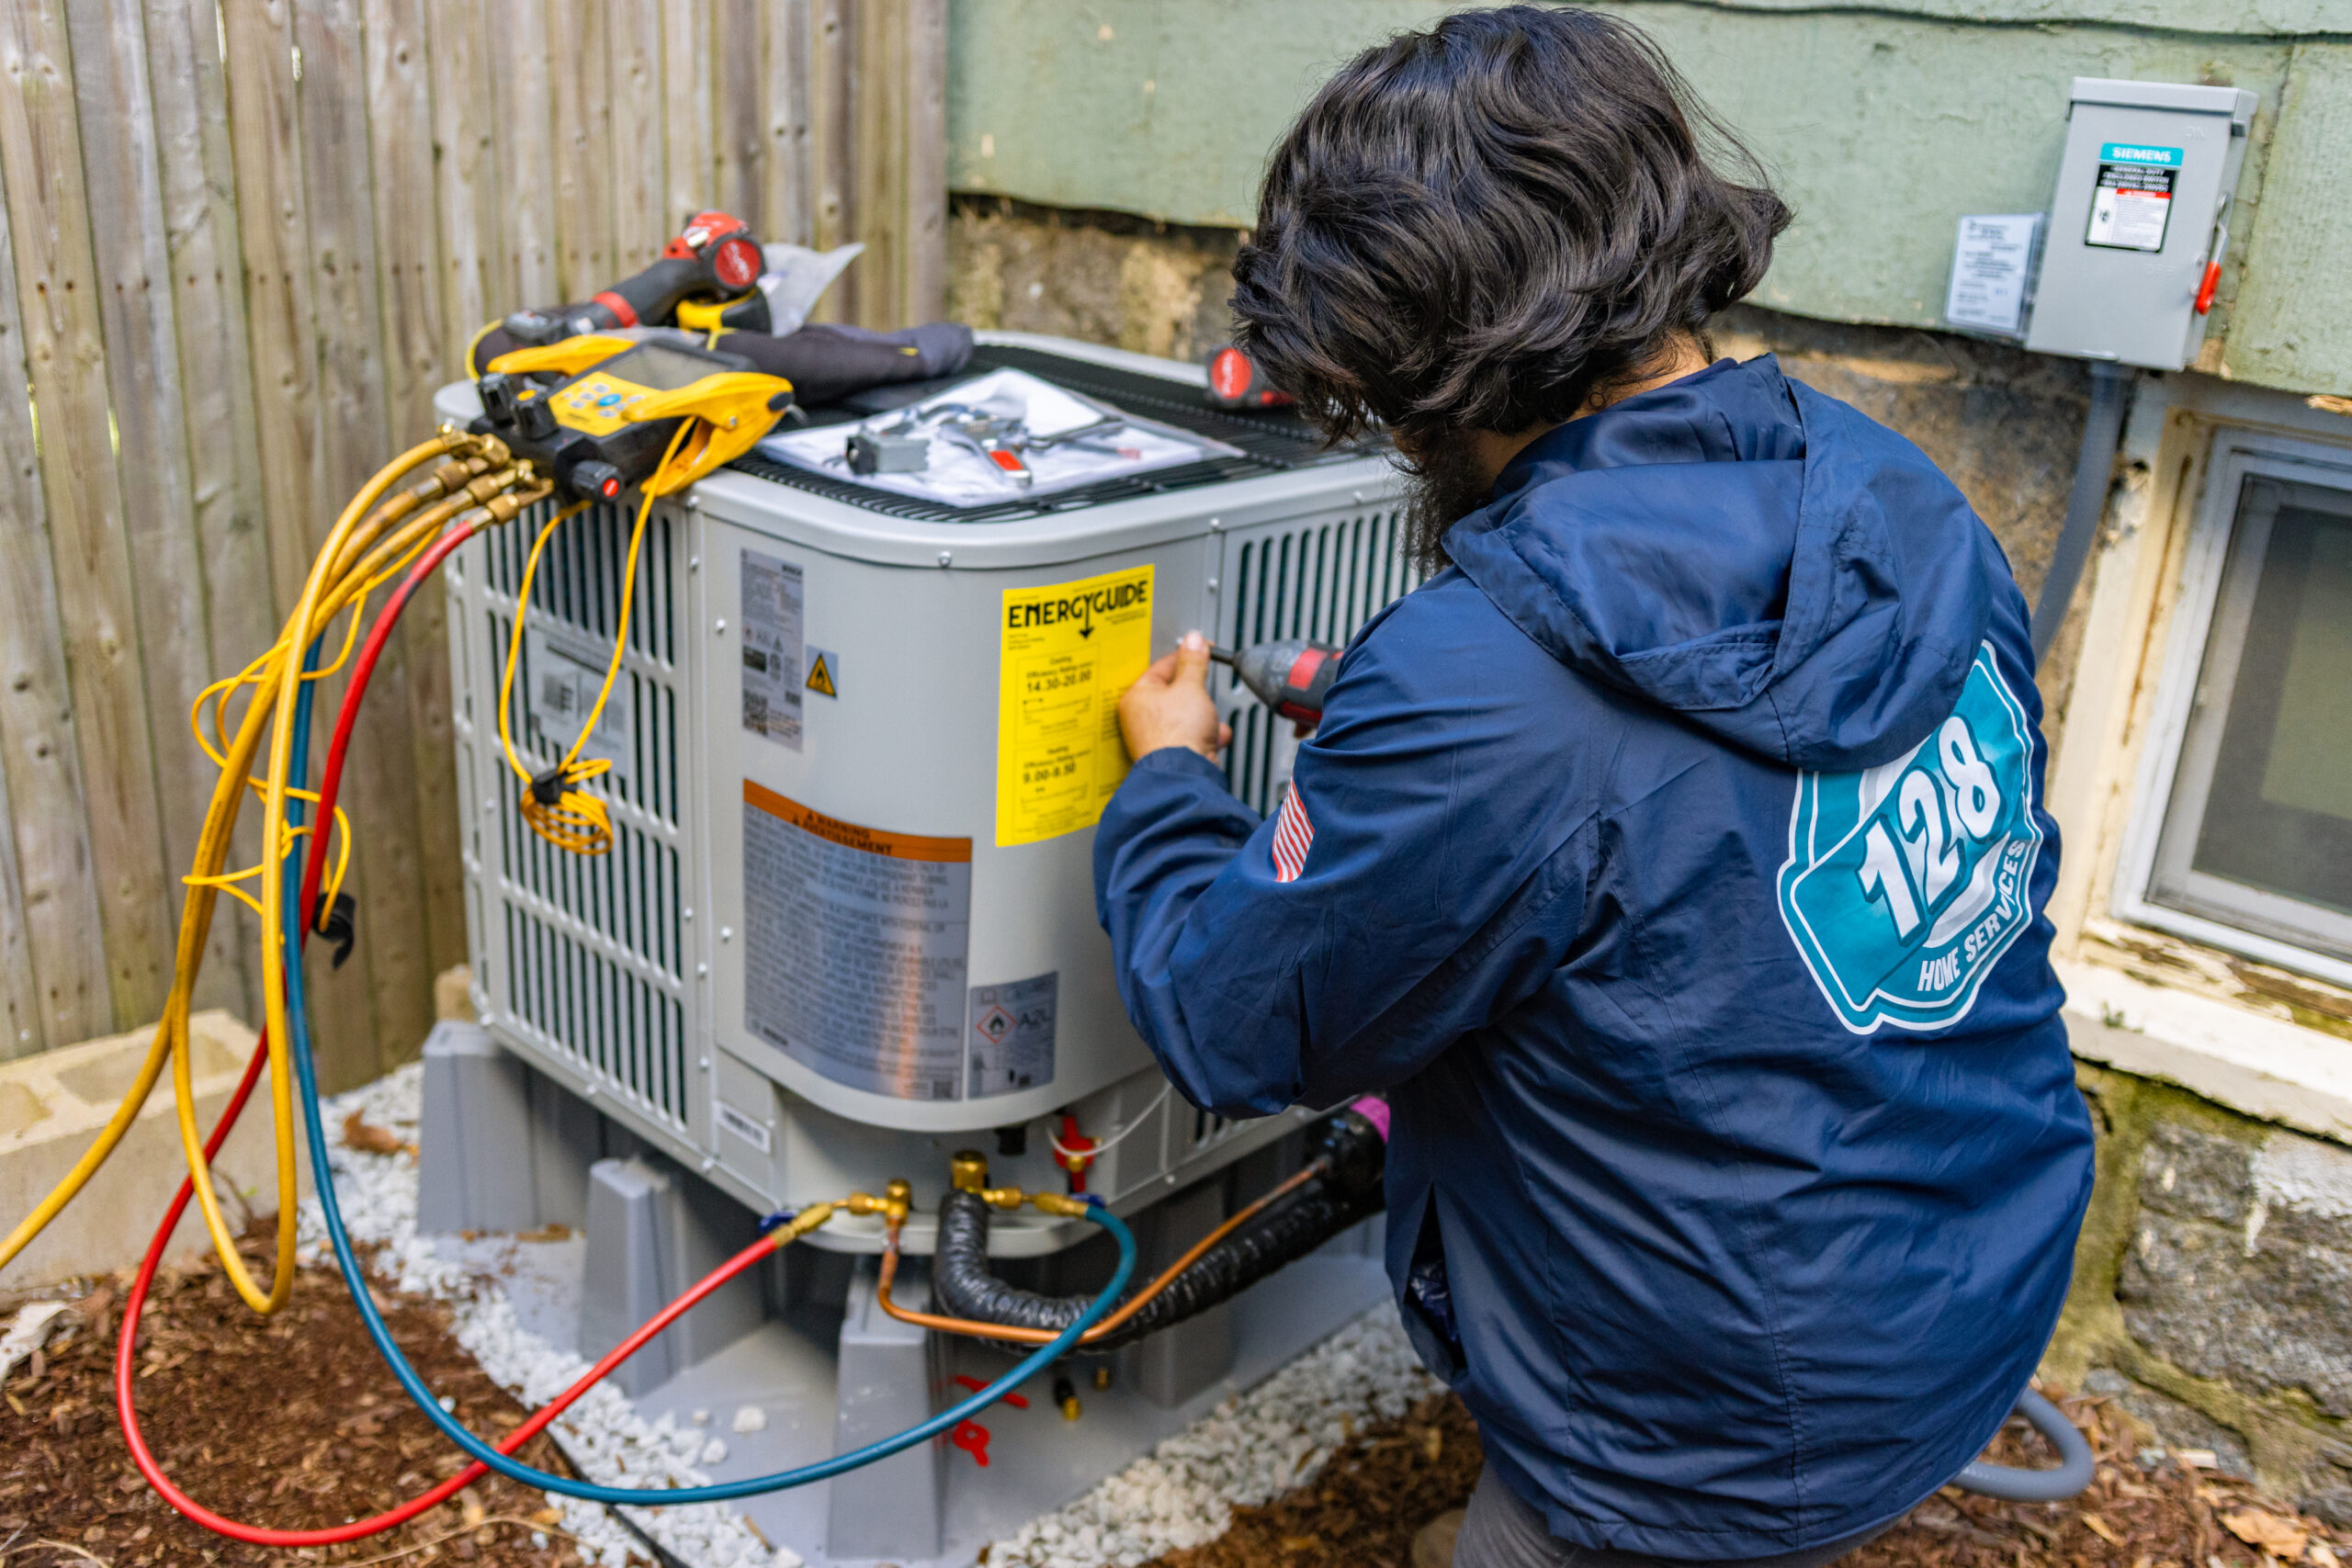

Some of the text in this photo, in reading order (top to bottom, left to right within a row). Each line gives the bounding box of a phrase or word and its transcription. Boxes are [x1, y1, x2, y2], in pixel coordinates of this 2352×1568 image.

[2111, 147, 2172, 163] SIEMENS
[1009, 580, 1148, 630] ENERGYGUIDE
[817, 815, 871, 840] WARNING
[1857, 715, 2002, 942] 128
[1917, 840, 2026, 992] HOME SERVICES
